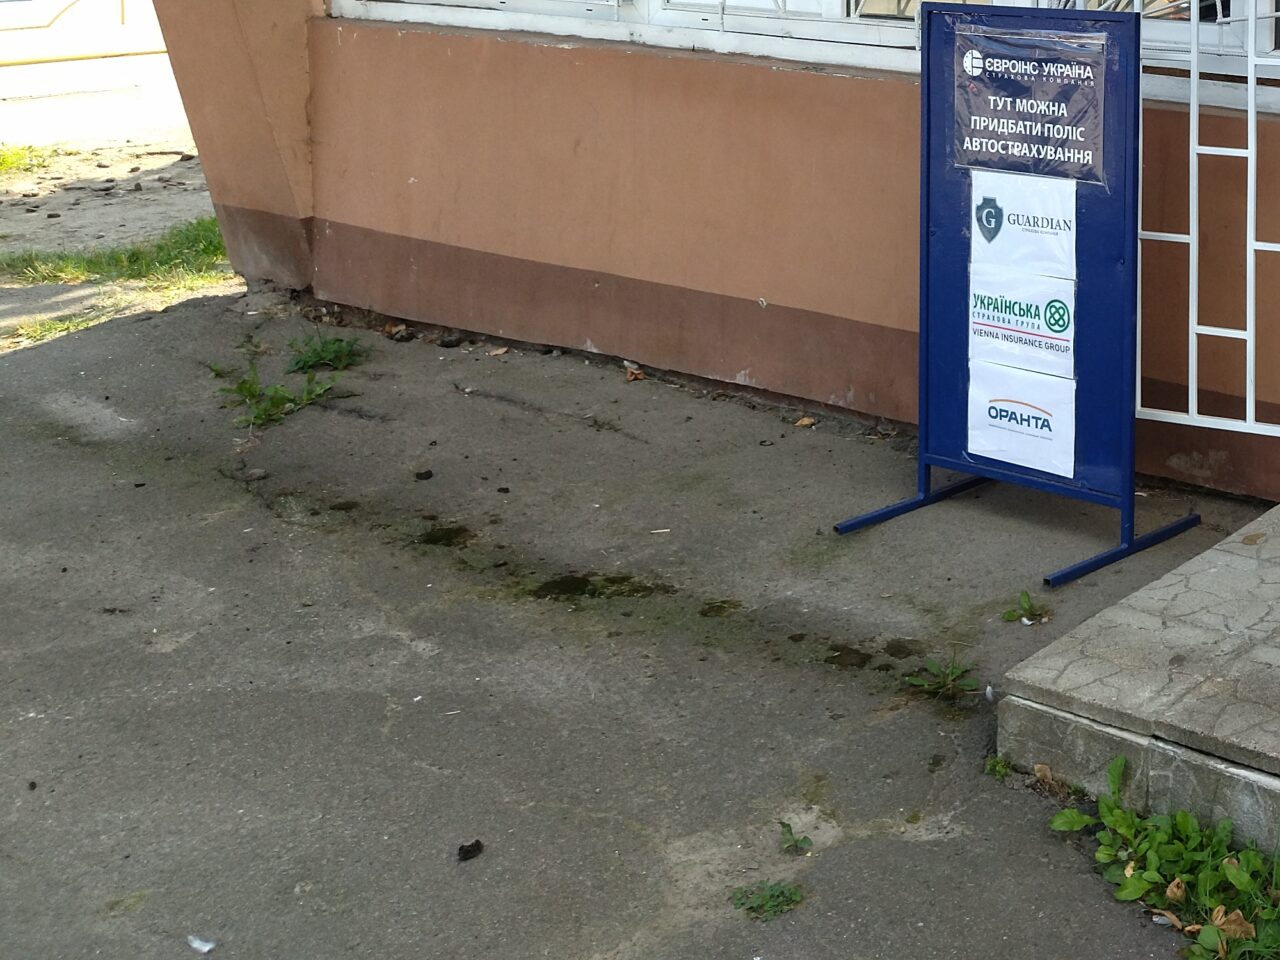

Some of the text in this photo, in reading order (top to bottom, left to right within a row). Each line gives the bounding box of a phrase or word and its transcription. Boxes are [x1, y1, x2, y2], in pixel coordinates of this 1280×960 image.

[985, 57, 1094, 80] ЄВРОІНС УКРАЇНА
[985, 71, 1096, 87] СТРАХОВА КОМПАНІЯ
[988, 95, 1068, 117] ТУТ МОЖНА
[970, 115, 1085, 141] ПРИДБАТИ ПОЛІС
[963, 137, 1093, 165] АВТОСТРАХУВАННЯ
[981, 209, 996, 228] G
[1007, 212, 1072, 232] GUARDIAN
[973, 293, 1041, 320] УКРАЇНСЬКА
[972, 311, 1041, 330] СТРАХОВА ГРУПА
[972, 327, 1071, 354] VIENNA INSURANCE GROUP
[987, 405, 1053, 432] ОРАНТА
